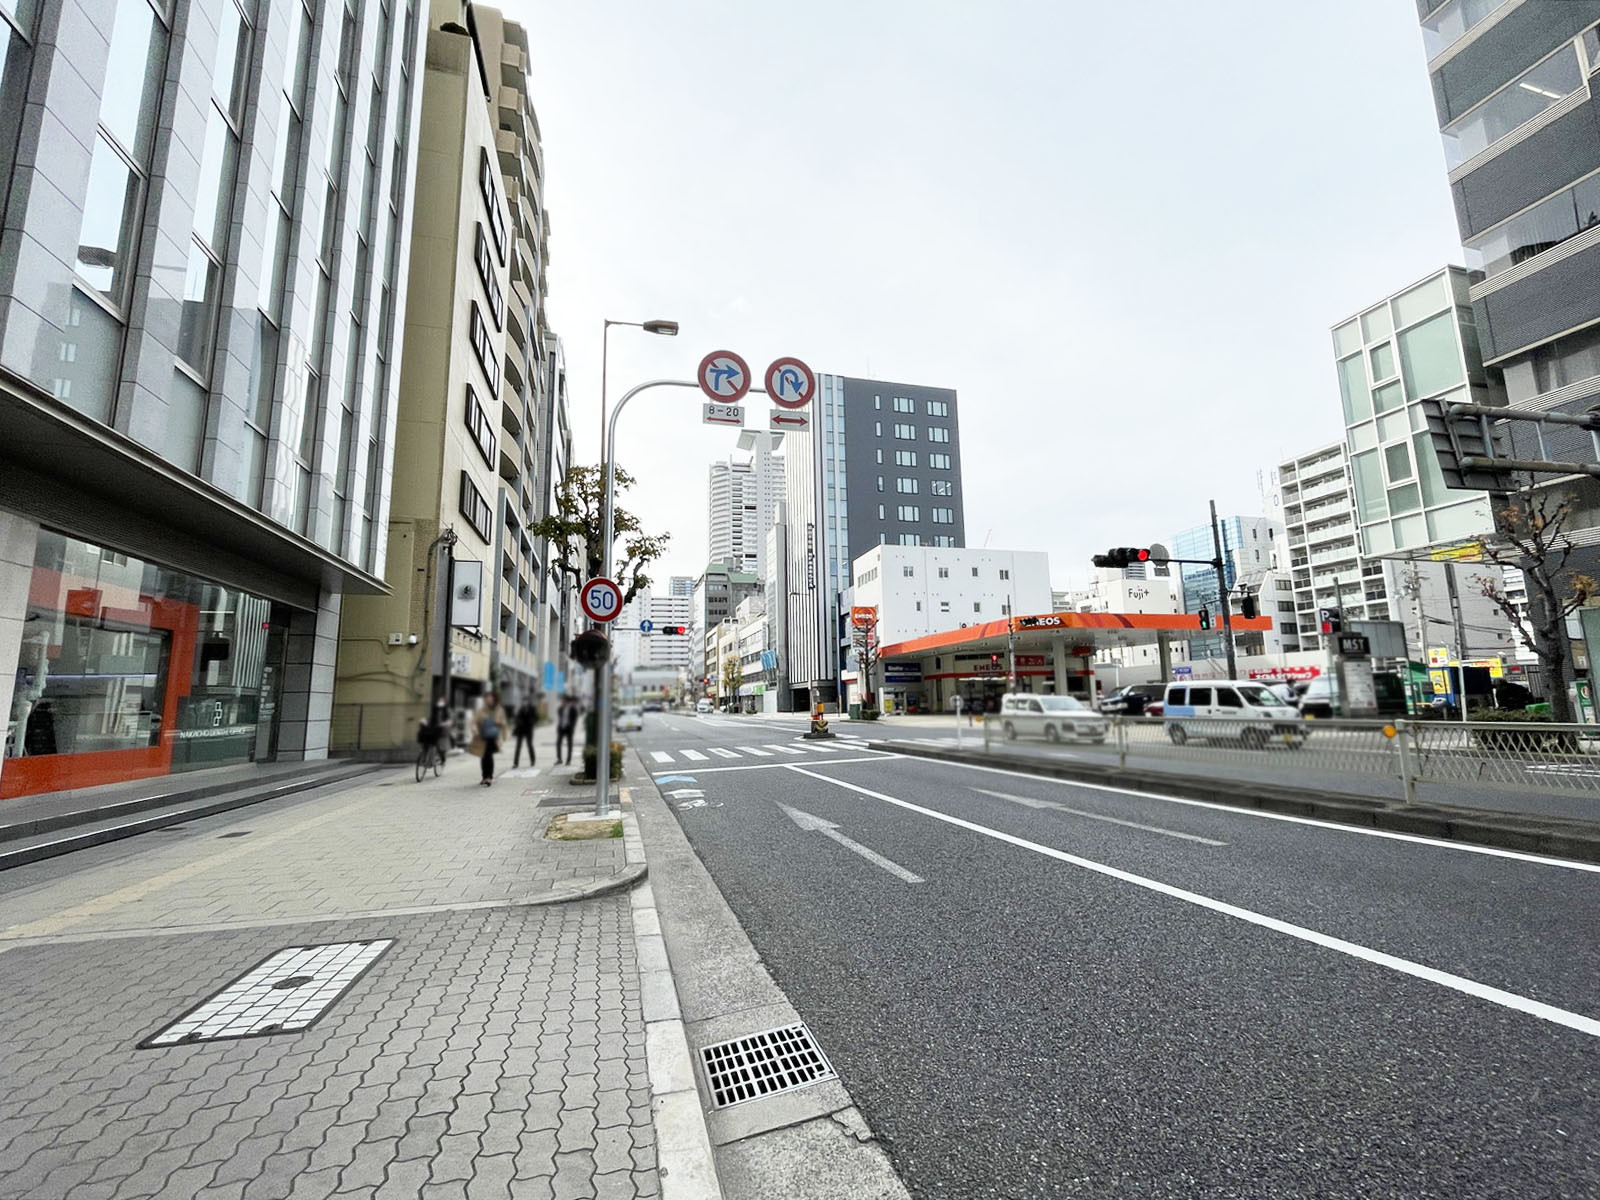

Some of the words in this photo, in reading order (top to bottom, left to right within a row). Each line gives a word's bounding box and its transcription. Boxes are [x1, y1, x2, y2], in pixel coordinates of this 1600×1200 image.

[708, 405, 739, 417] 8-20
[590, 590, 614, 610] 50
[1321, 610, 1330, 621] P
[1343, 638, 1365, 650] MST
